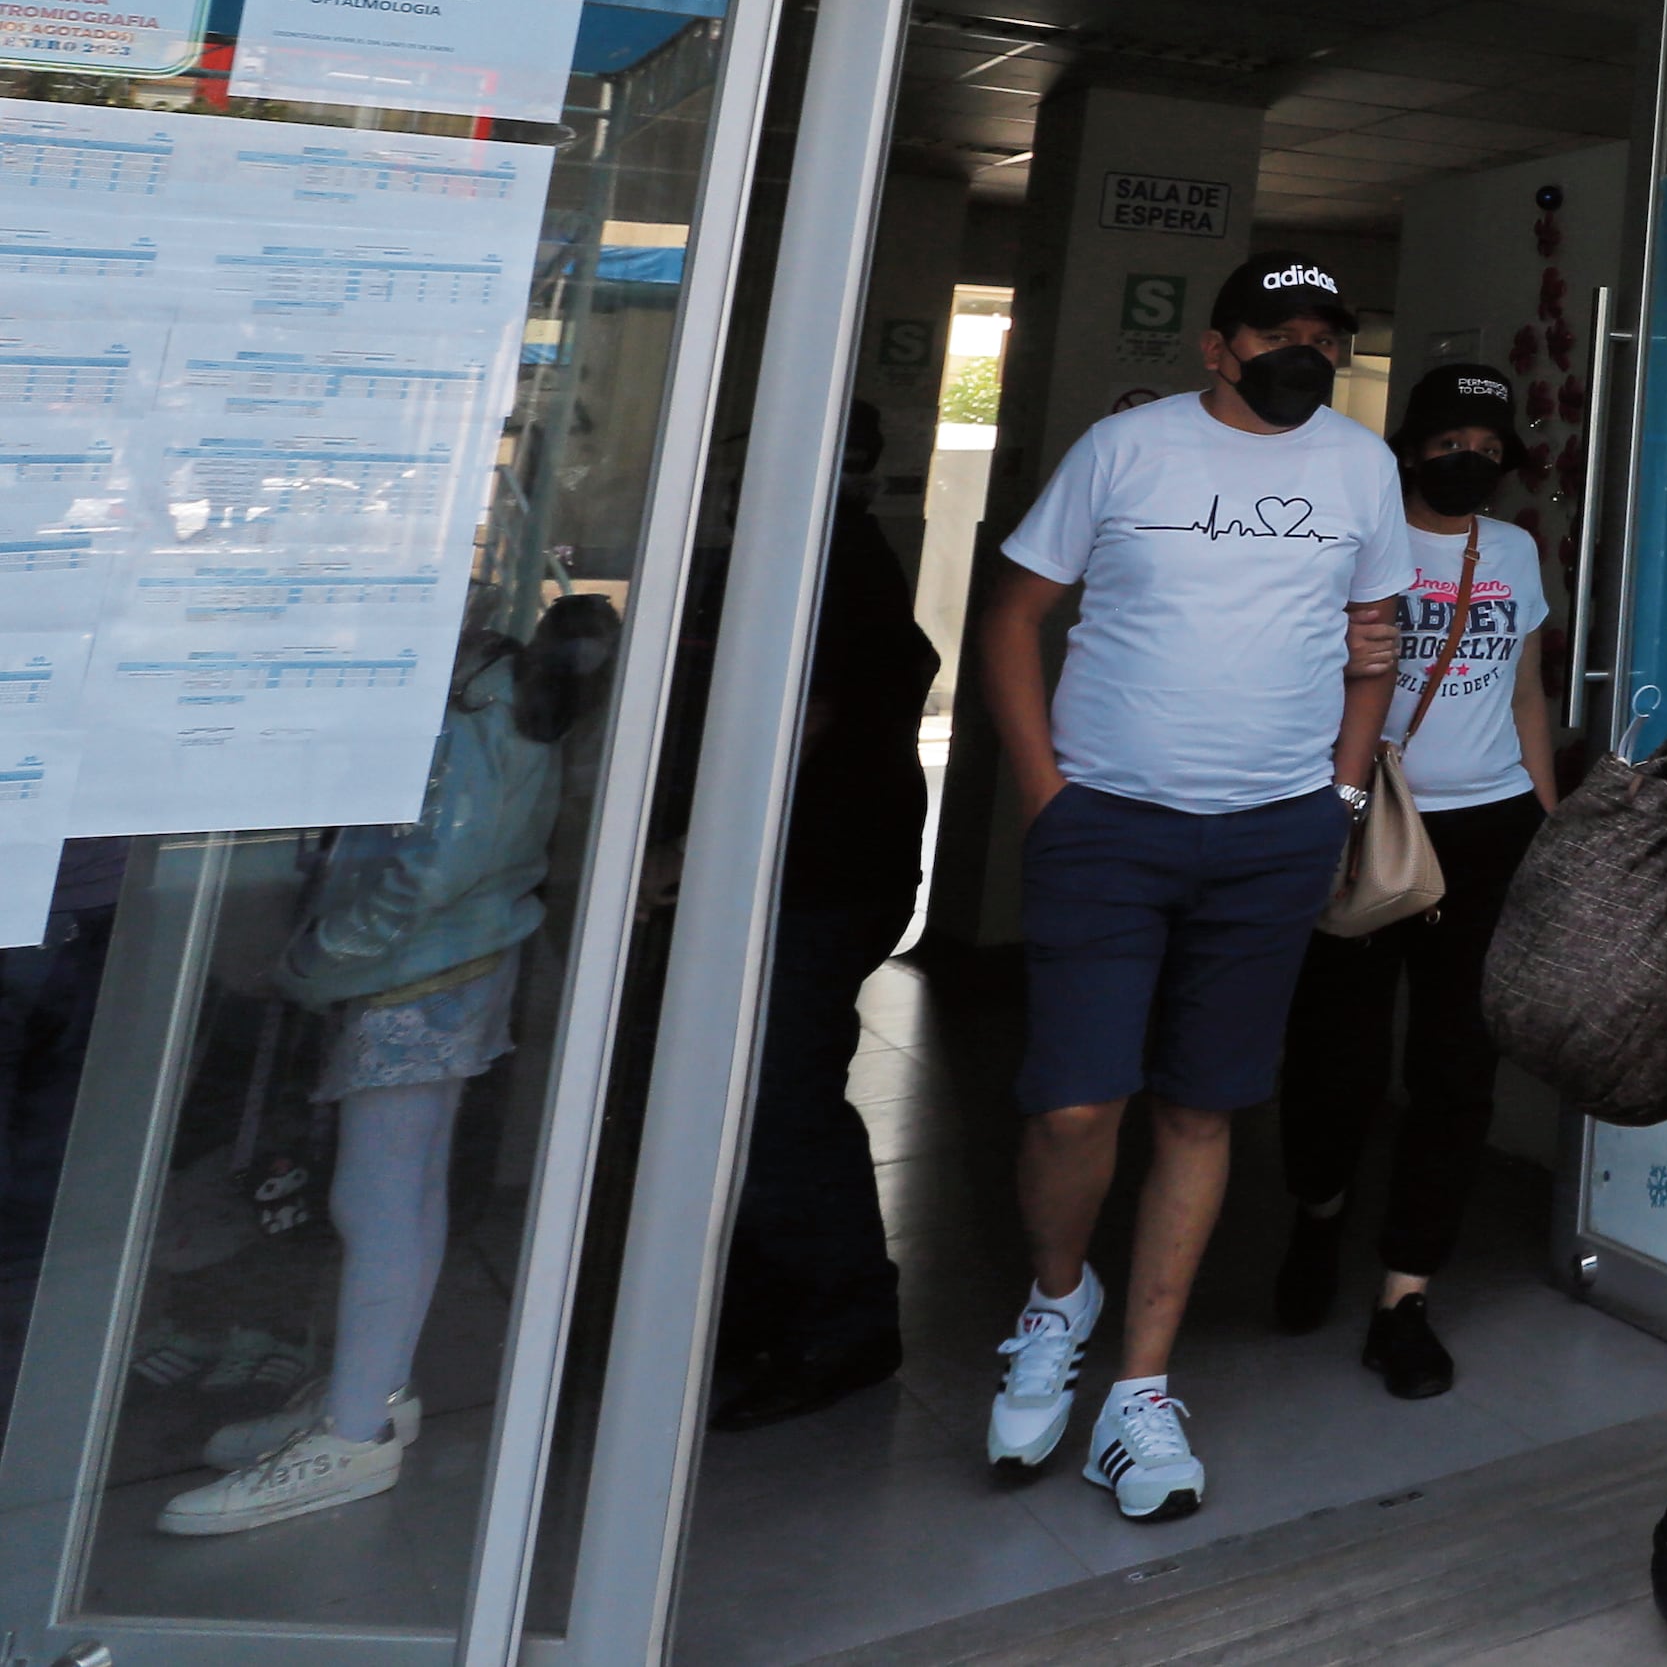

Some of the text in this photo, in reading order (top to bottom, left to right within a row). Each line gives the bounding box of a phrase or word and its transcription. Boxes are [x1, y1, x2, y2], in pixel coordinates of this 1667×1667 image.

[1115, 179, 1220, 208] SALA DE
[1114, 204, 1213, 232] ESPERA
[1263, 265, 1338, 294] adidas
[1398, 636, 1518, 661] ROOKLYN
